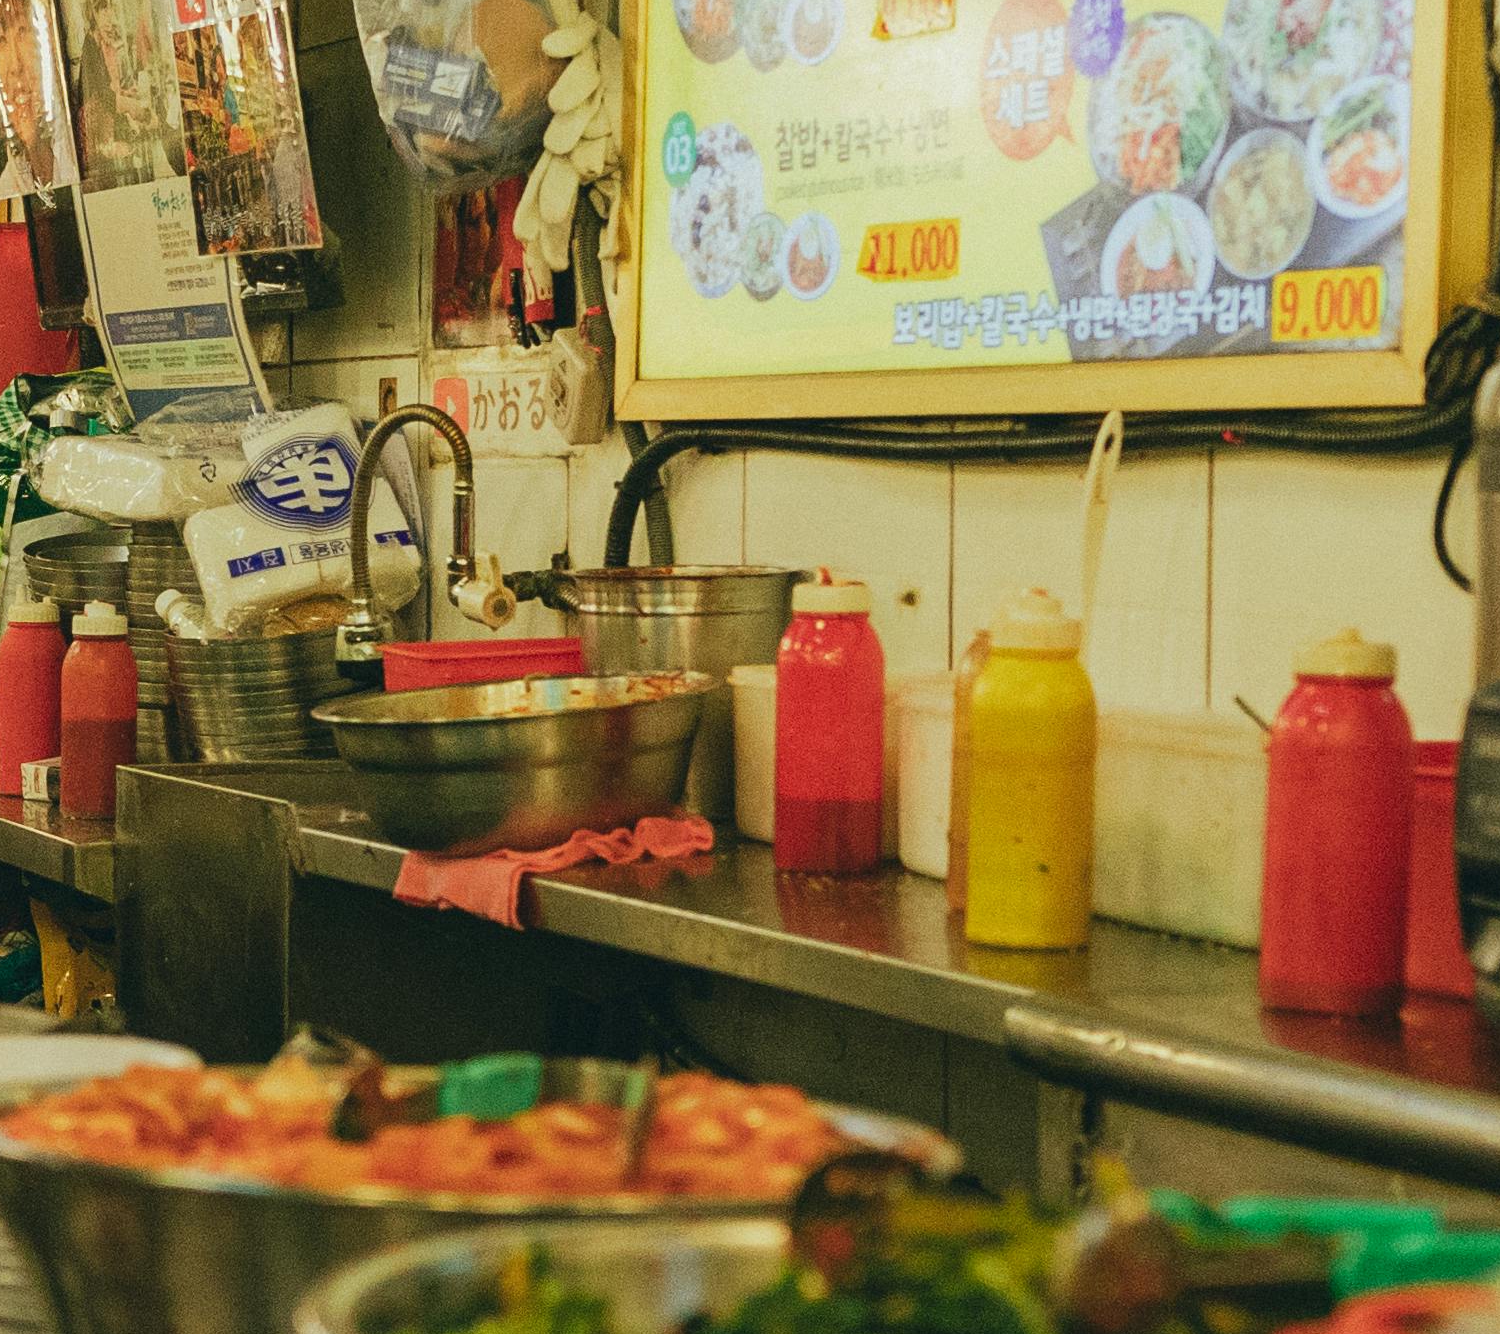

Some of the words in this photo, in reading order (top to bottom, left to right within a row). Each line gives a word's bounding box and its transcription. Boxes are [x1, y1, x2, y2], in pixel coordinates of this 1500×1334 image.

[984, 23, 1066, 81] 스페셜
[995, 78, 1050, 131] 세트
[665, 136, 693, 176] 03
[775, 106, 952, 173] 찰밥+칼국수+냉면
[1278, 275, 1380, 339] 9.000
[472, 375, 549, 433] かおる
[296, 538, 351, 560] 생용품
